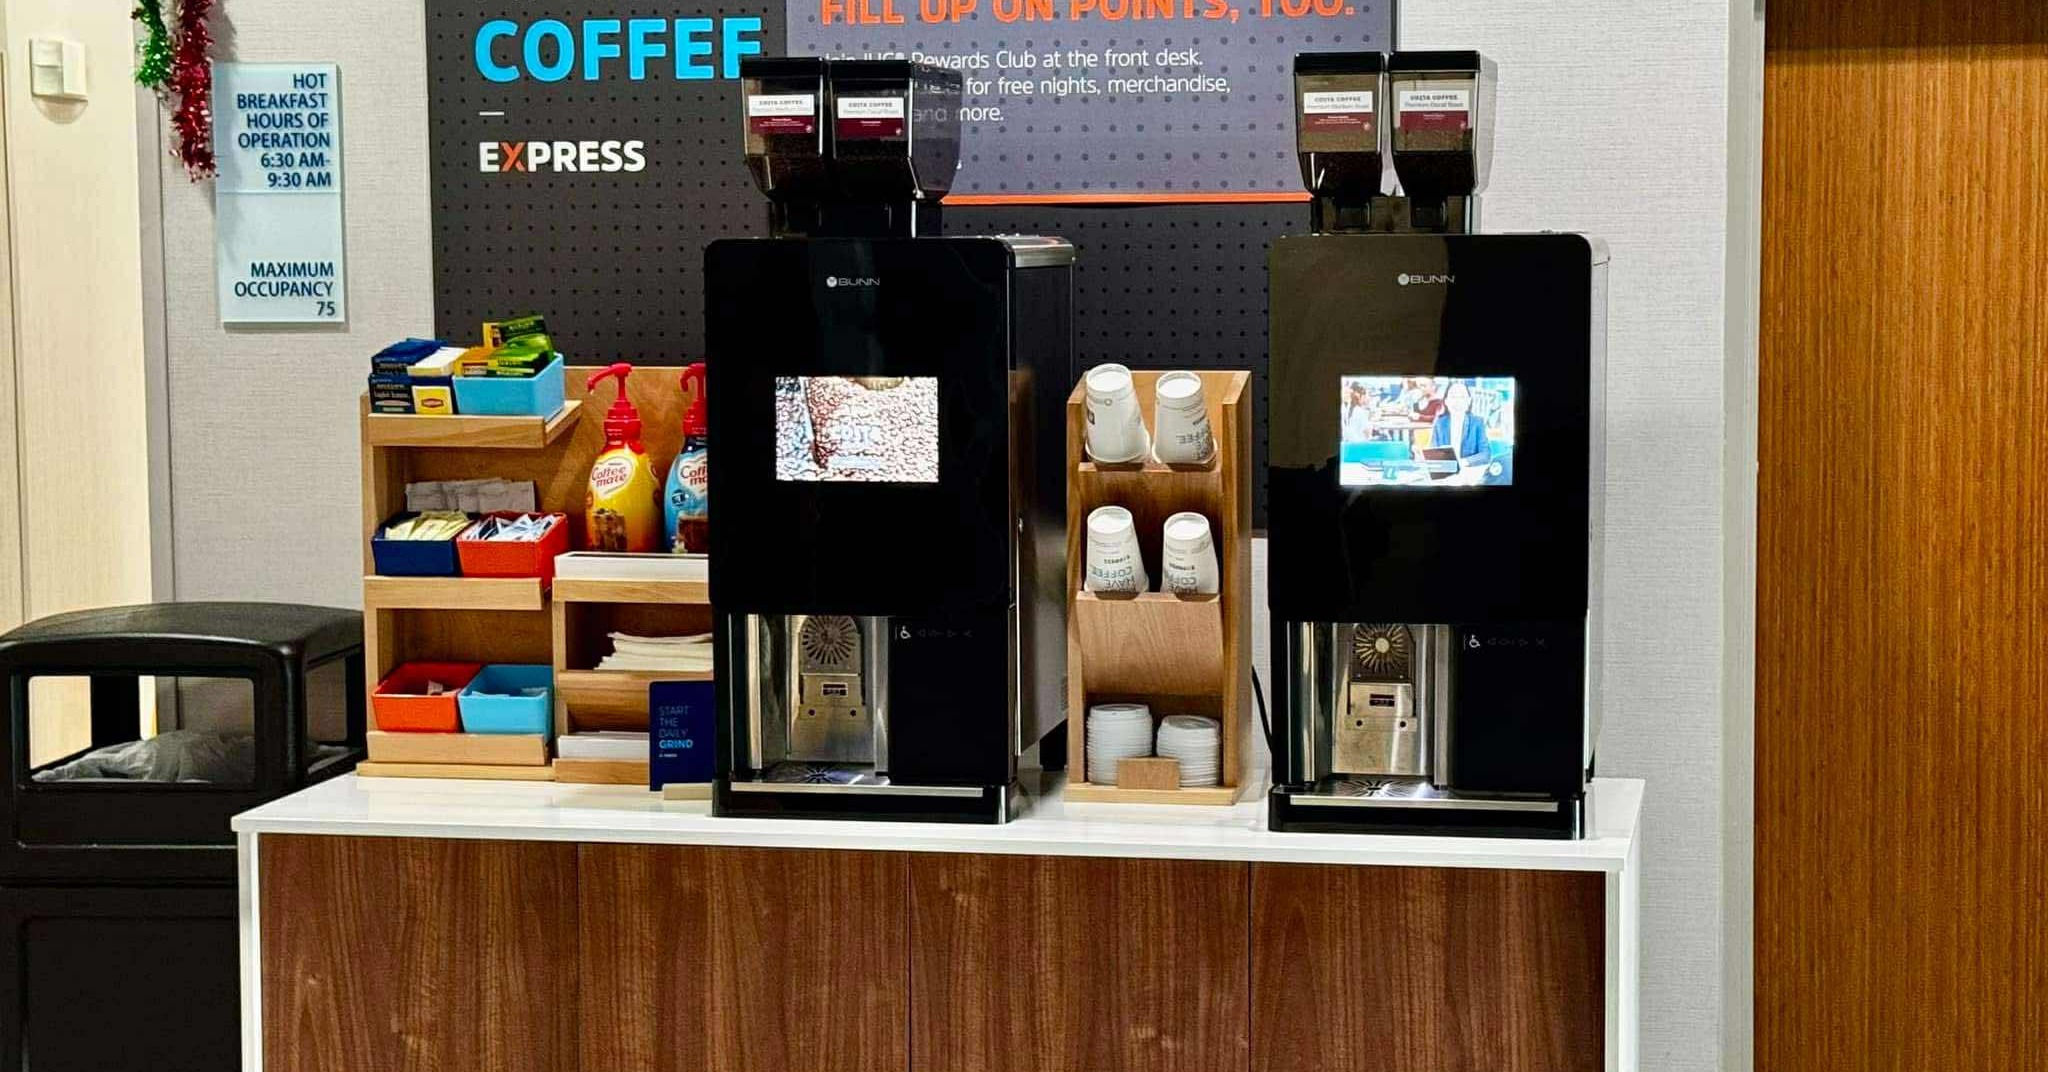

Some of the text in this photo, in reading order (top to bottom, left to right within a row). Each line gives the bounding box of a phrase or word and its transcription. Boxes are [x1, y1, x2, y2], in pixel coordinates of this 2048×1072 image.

[821, 0, 905, 25] FILL
[919, 0, 977, 24] UP
[992, 0, 1054, 24] ON
[474, 17, 762, 82] COFFEE
[996, 50, 1036, 69] Club
[1043, 52, 1061, 68] at
[1068, 50, 1098, 67] the
[1104, 49, 1149, 67] front
[1155, 47, 1203, 66] desk.
[293, 73, 327, 89] HOT
[966, 78, 990, 95] for
[998, 77, 1034, 95] free
[1040, 76, 1101, 97] nights,
[1107, 75, 1231, 94] merchandise,
[237, 93, 328, 109] BREAKFAST
[247, 113, 328, 129] HOURS OF
[238, 132, 330, 149] OPERATION
[261, 152, 330, 168] 6:30 AM-
[479, 141, 647, 173] EXPRESS
[267, 172, 331, 188] 9:30 AM
[250, 262, 334, 277] MAXIMUM
[838, 277, 880, 286] BUNN
[1410, 275, 1456, 284] BUNN
[235, 281, 333, 297] OCCUPANCY
[316, 301, 335, 316] 75
[659, 705, 689, 717] START
[660, 717, 680, 727] THE
[659, 739, 694, 750] GRIND
